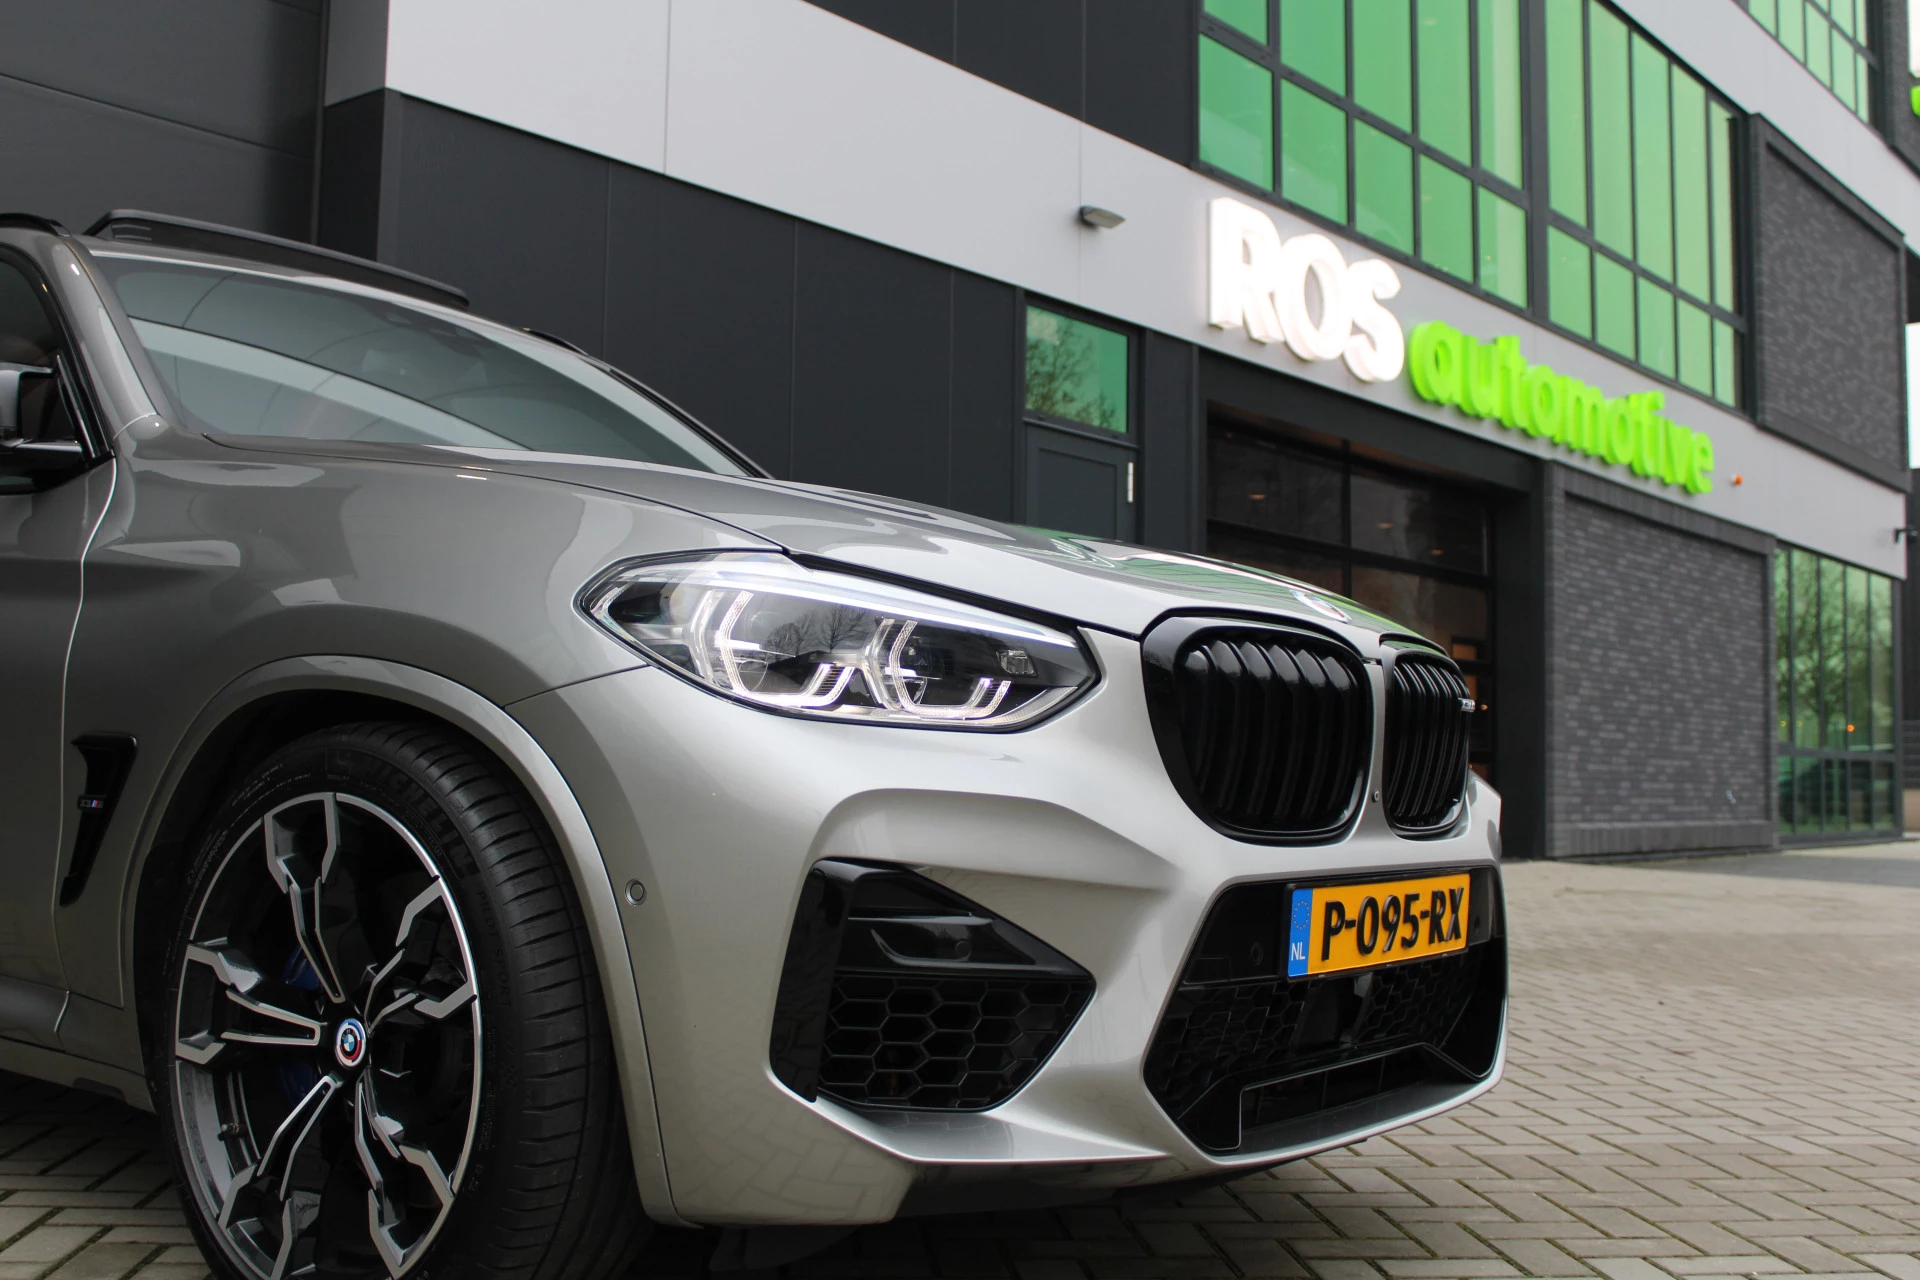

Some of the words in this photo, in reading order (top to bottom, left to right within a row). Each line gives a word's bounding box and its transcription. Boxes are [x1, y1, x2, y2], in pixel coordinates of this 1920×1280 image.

[1208, 197, 1404, 382] ROS
[1409, 320, 1715, 494] automotive
[476, 890, 499, 938] PILOT
[494, 948, 512, 1008] SPORT
[1290, 942, 1306, 961] NL
[1321, 887, 1464, 962] P-095-RX
